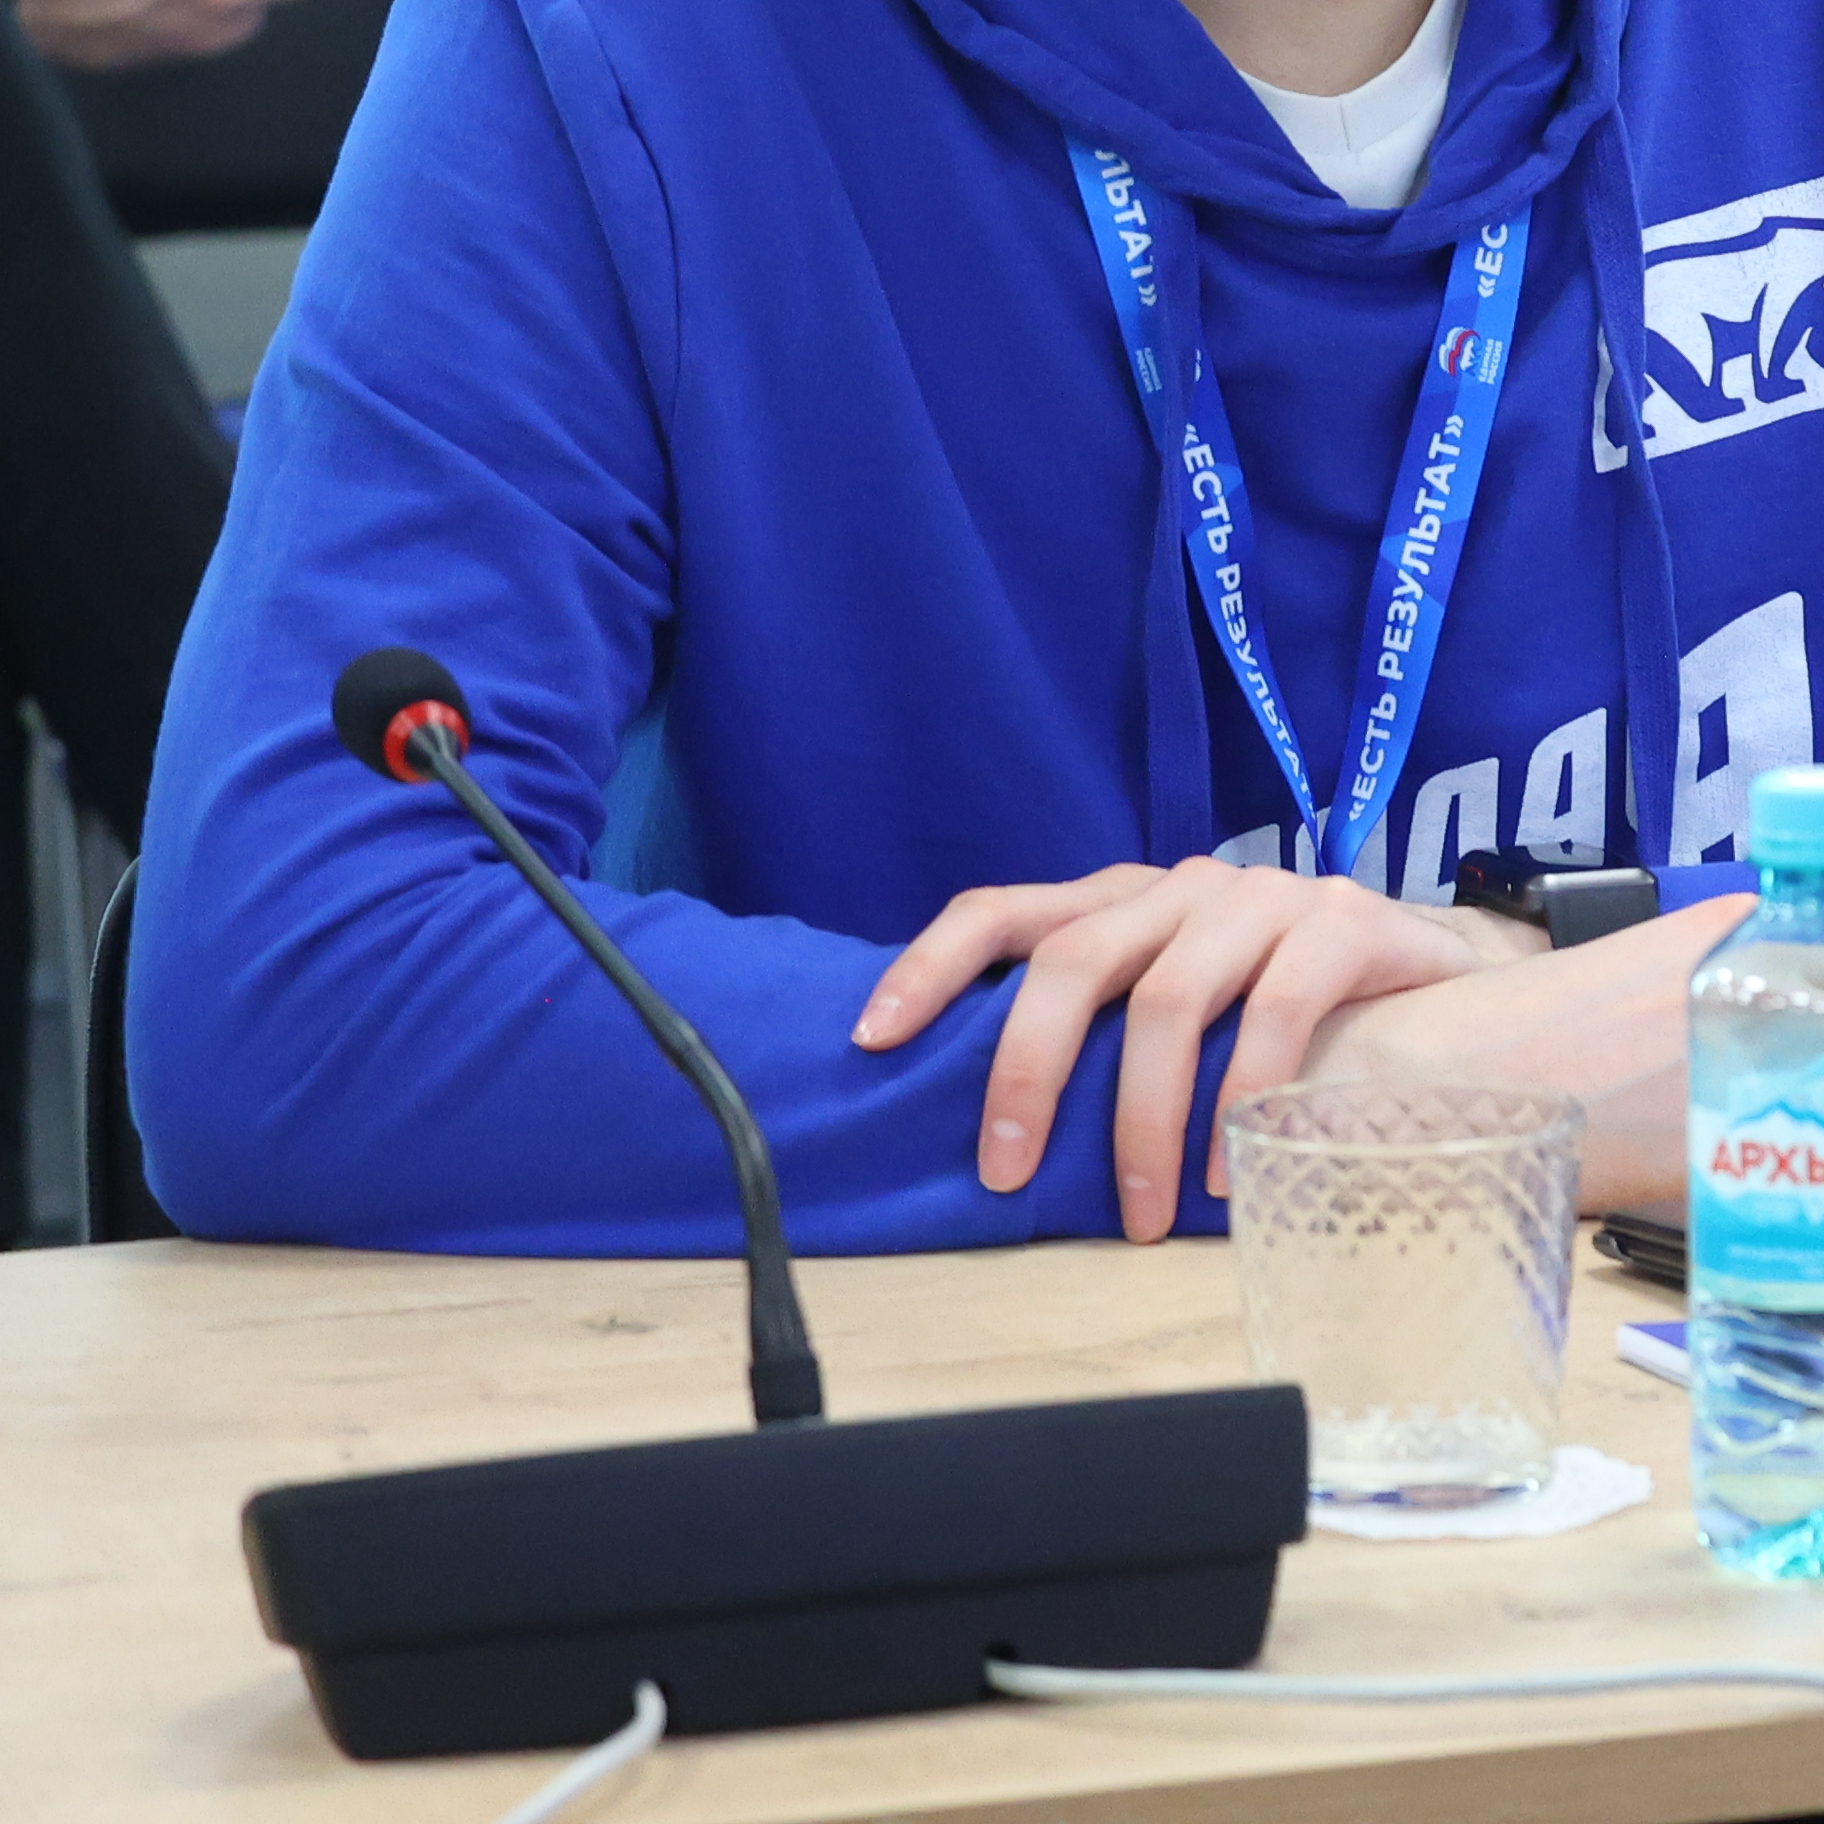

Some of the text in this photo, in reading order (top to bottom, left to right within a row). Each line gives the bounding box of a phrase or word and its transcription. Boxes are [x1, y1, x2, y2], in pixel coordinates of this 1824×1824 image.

[1475, 223, 1509, 298] «ЕС
[1182, 422, 1234, 555] «ЕСТЬ
[1348, 414, 1465, 822] «ЕСТЬ РЕЗУЛЬТАТ»
